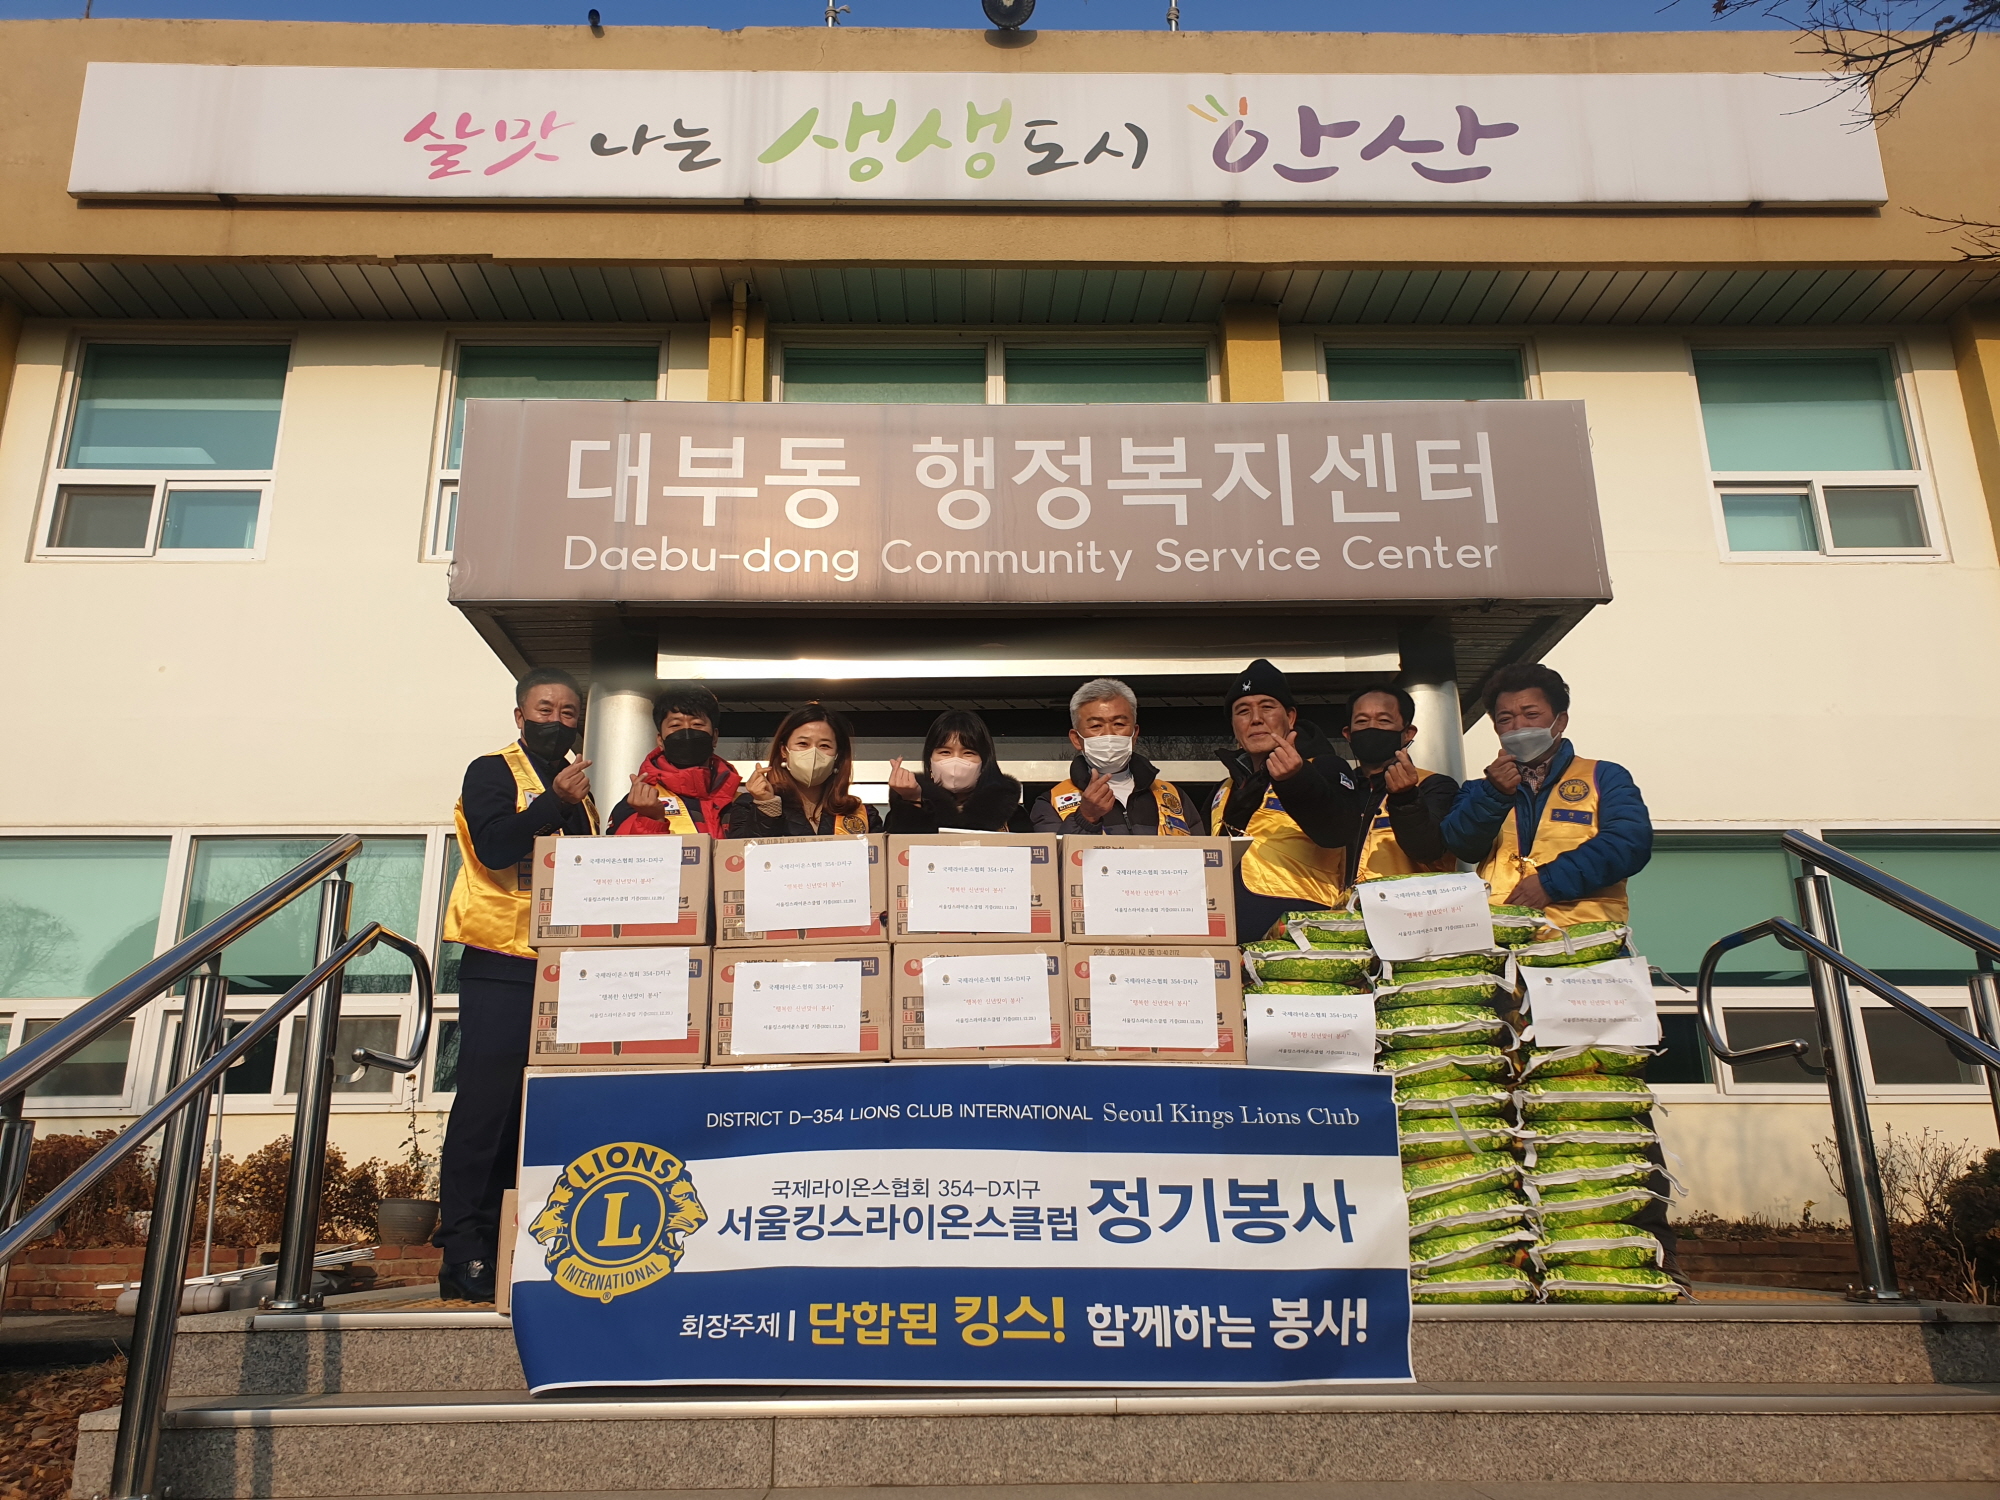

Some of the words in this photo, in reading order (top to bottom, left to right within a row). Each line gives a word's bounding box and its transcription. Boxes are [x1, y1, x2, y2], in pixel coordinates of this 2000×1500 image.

[1212, 103, 1520, 184] 안산
[566, 432, 861, 530] 대부동
[912, 432, 1498, 530] 행정복지센터
[564, 535, 859, 582] Daebu-dong
[881, 538, 1133, 581] Community
[1155, 537, 1321, 573] Service
[1342, 535, 1498, 570] Center
[707, 1110, 783, 1128] DISTRICT
[789, 1108, 844, 1125] D-354
[850, 1104, 901, 1121] LIONS
[906, 1103, 953, 1118] CLUB
[959, 1103, 1094, 1120] INTERNATIONAL
[1103, 1102, 1163, 1123] Seoul
[1170, 1103, 1234, 1129] Kings
[1239, 1105, 1301, 1125] Lions
[1307, 1107, 1360, 1126] Club
[573, 1145, 675, 1185] LIONS
[771, 1177, 929, 1200] 국제라이온스협회
[938, 1179, 1041, 1200] 354-D지구
[597, 1191, 642, 1247] L
[717, 1203, 1078, 1242] 서울킹스라이온스클럽
[1086, 1176, 1358, 1244] 정기봉사
[562, 1259, 663, 1291] INTERNATIONAL
[680, 1312, 780, 1339] 회장주제
[808, 1301, 937, 1346] 단합된
[954, 1296, 1066, 1347] 킹스!
[1086, 1303, 1256, 1349] 함께하는
[1269, 1297, 1367, 1349] 봉사!
